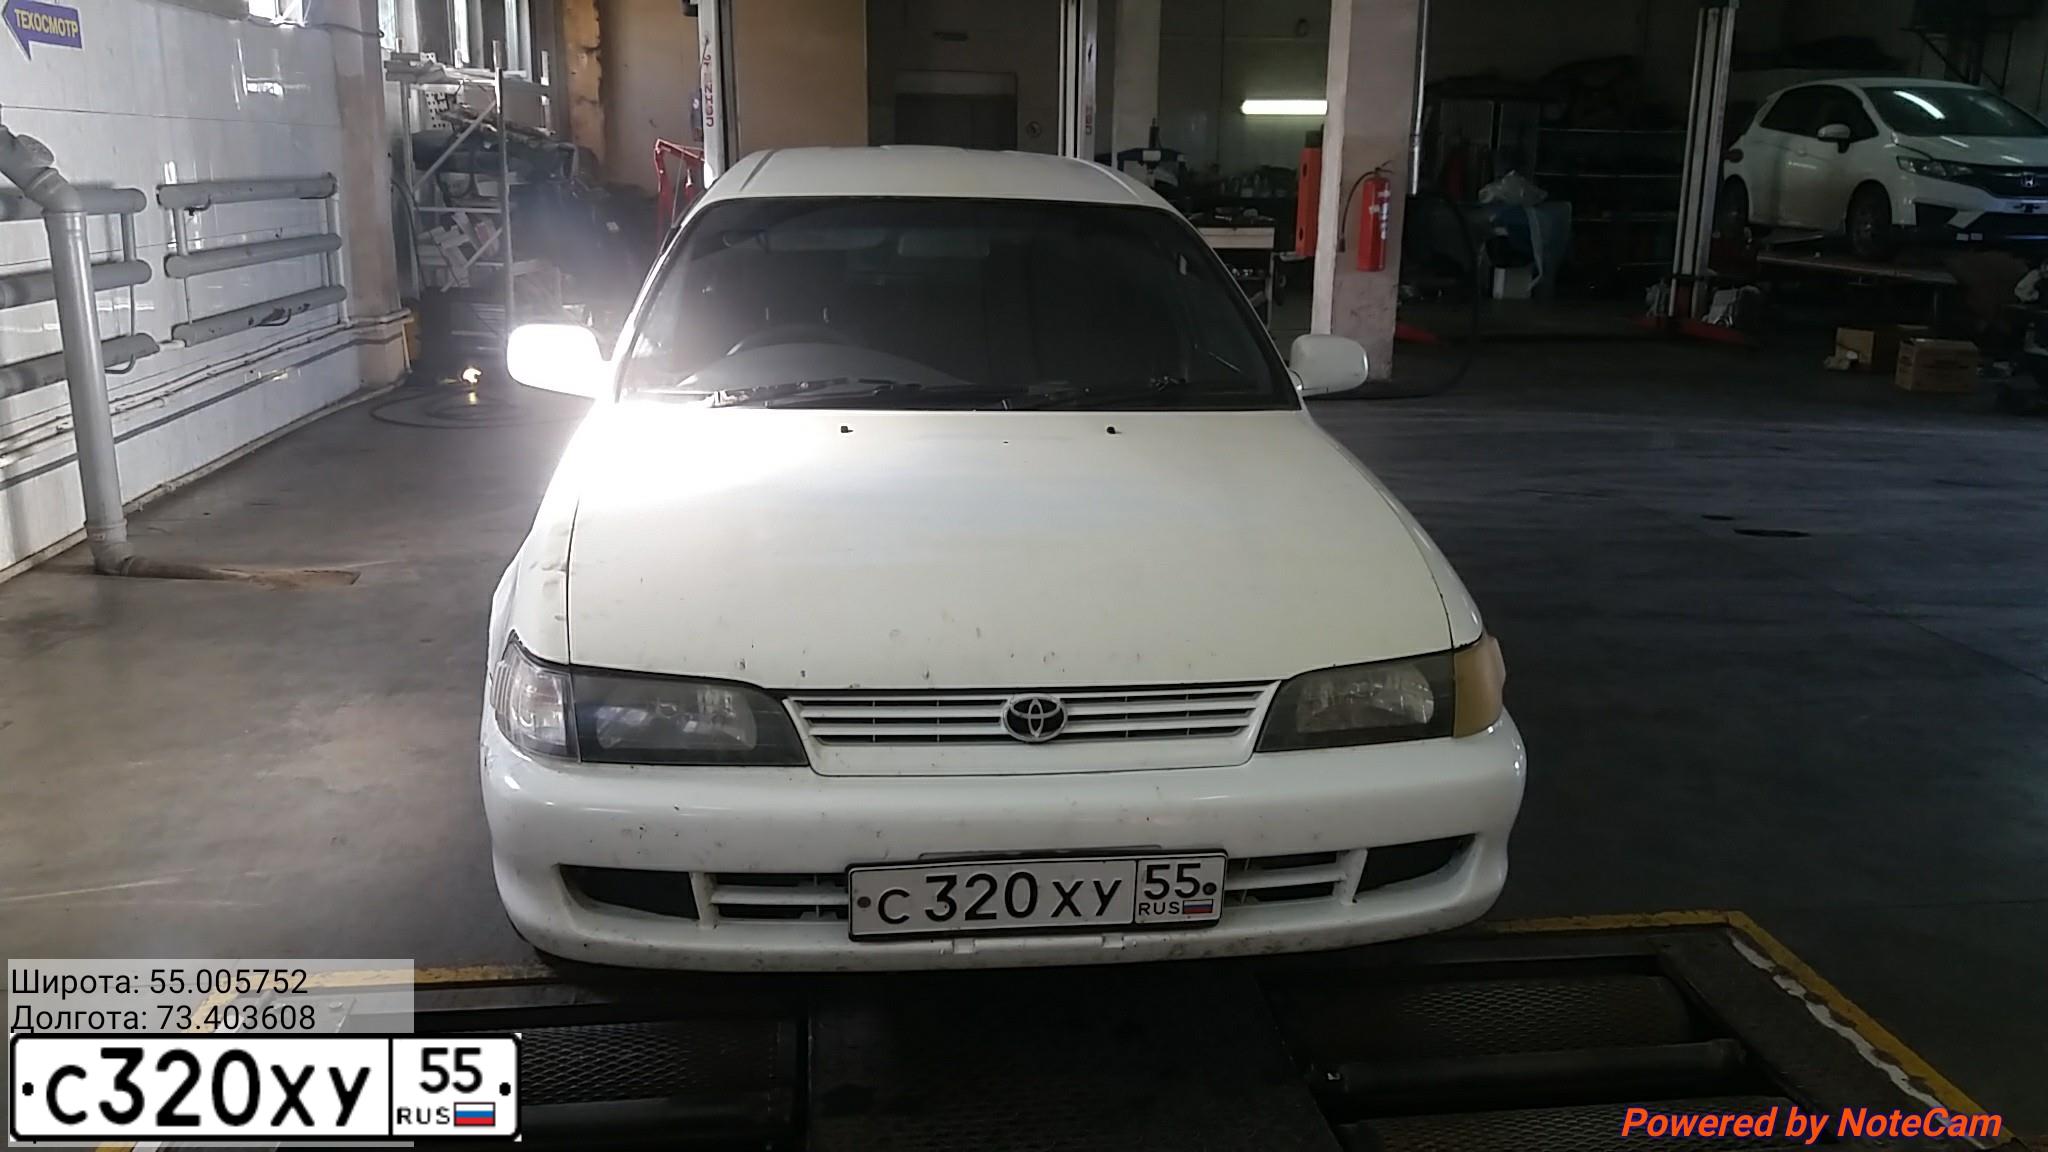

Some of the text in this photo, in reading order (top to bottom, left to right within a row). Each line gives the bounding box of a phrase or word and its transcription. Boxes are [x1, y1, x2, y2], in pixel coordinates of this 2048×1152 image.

[14, 8, 79, 38] ТЕХОСМОТР
[1143, 863, 1201, 900] 55
[1138, 901, 1180, 917] RUS
